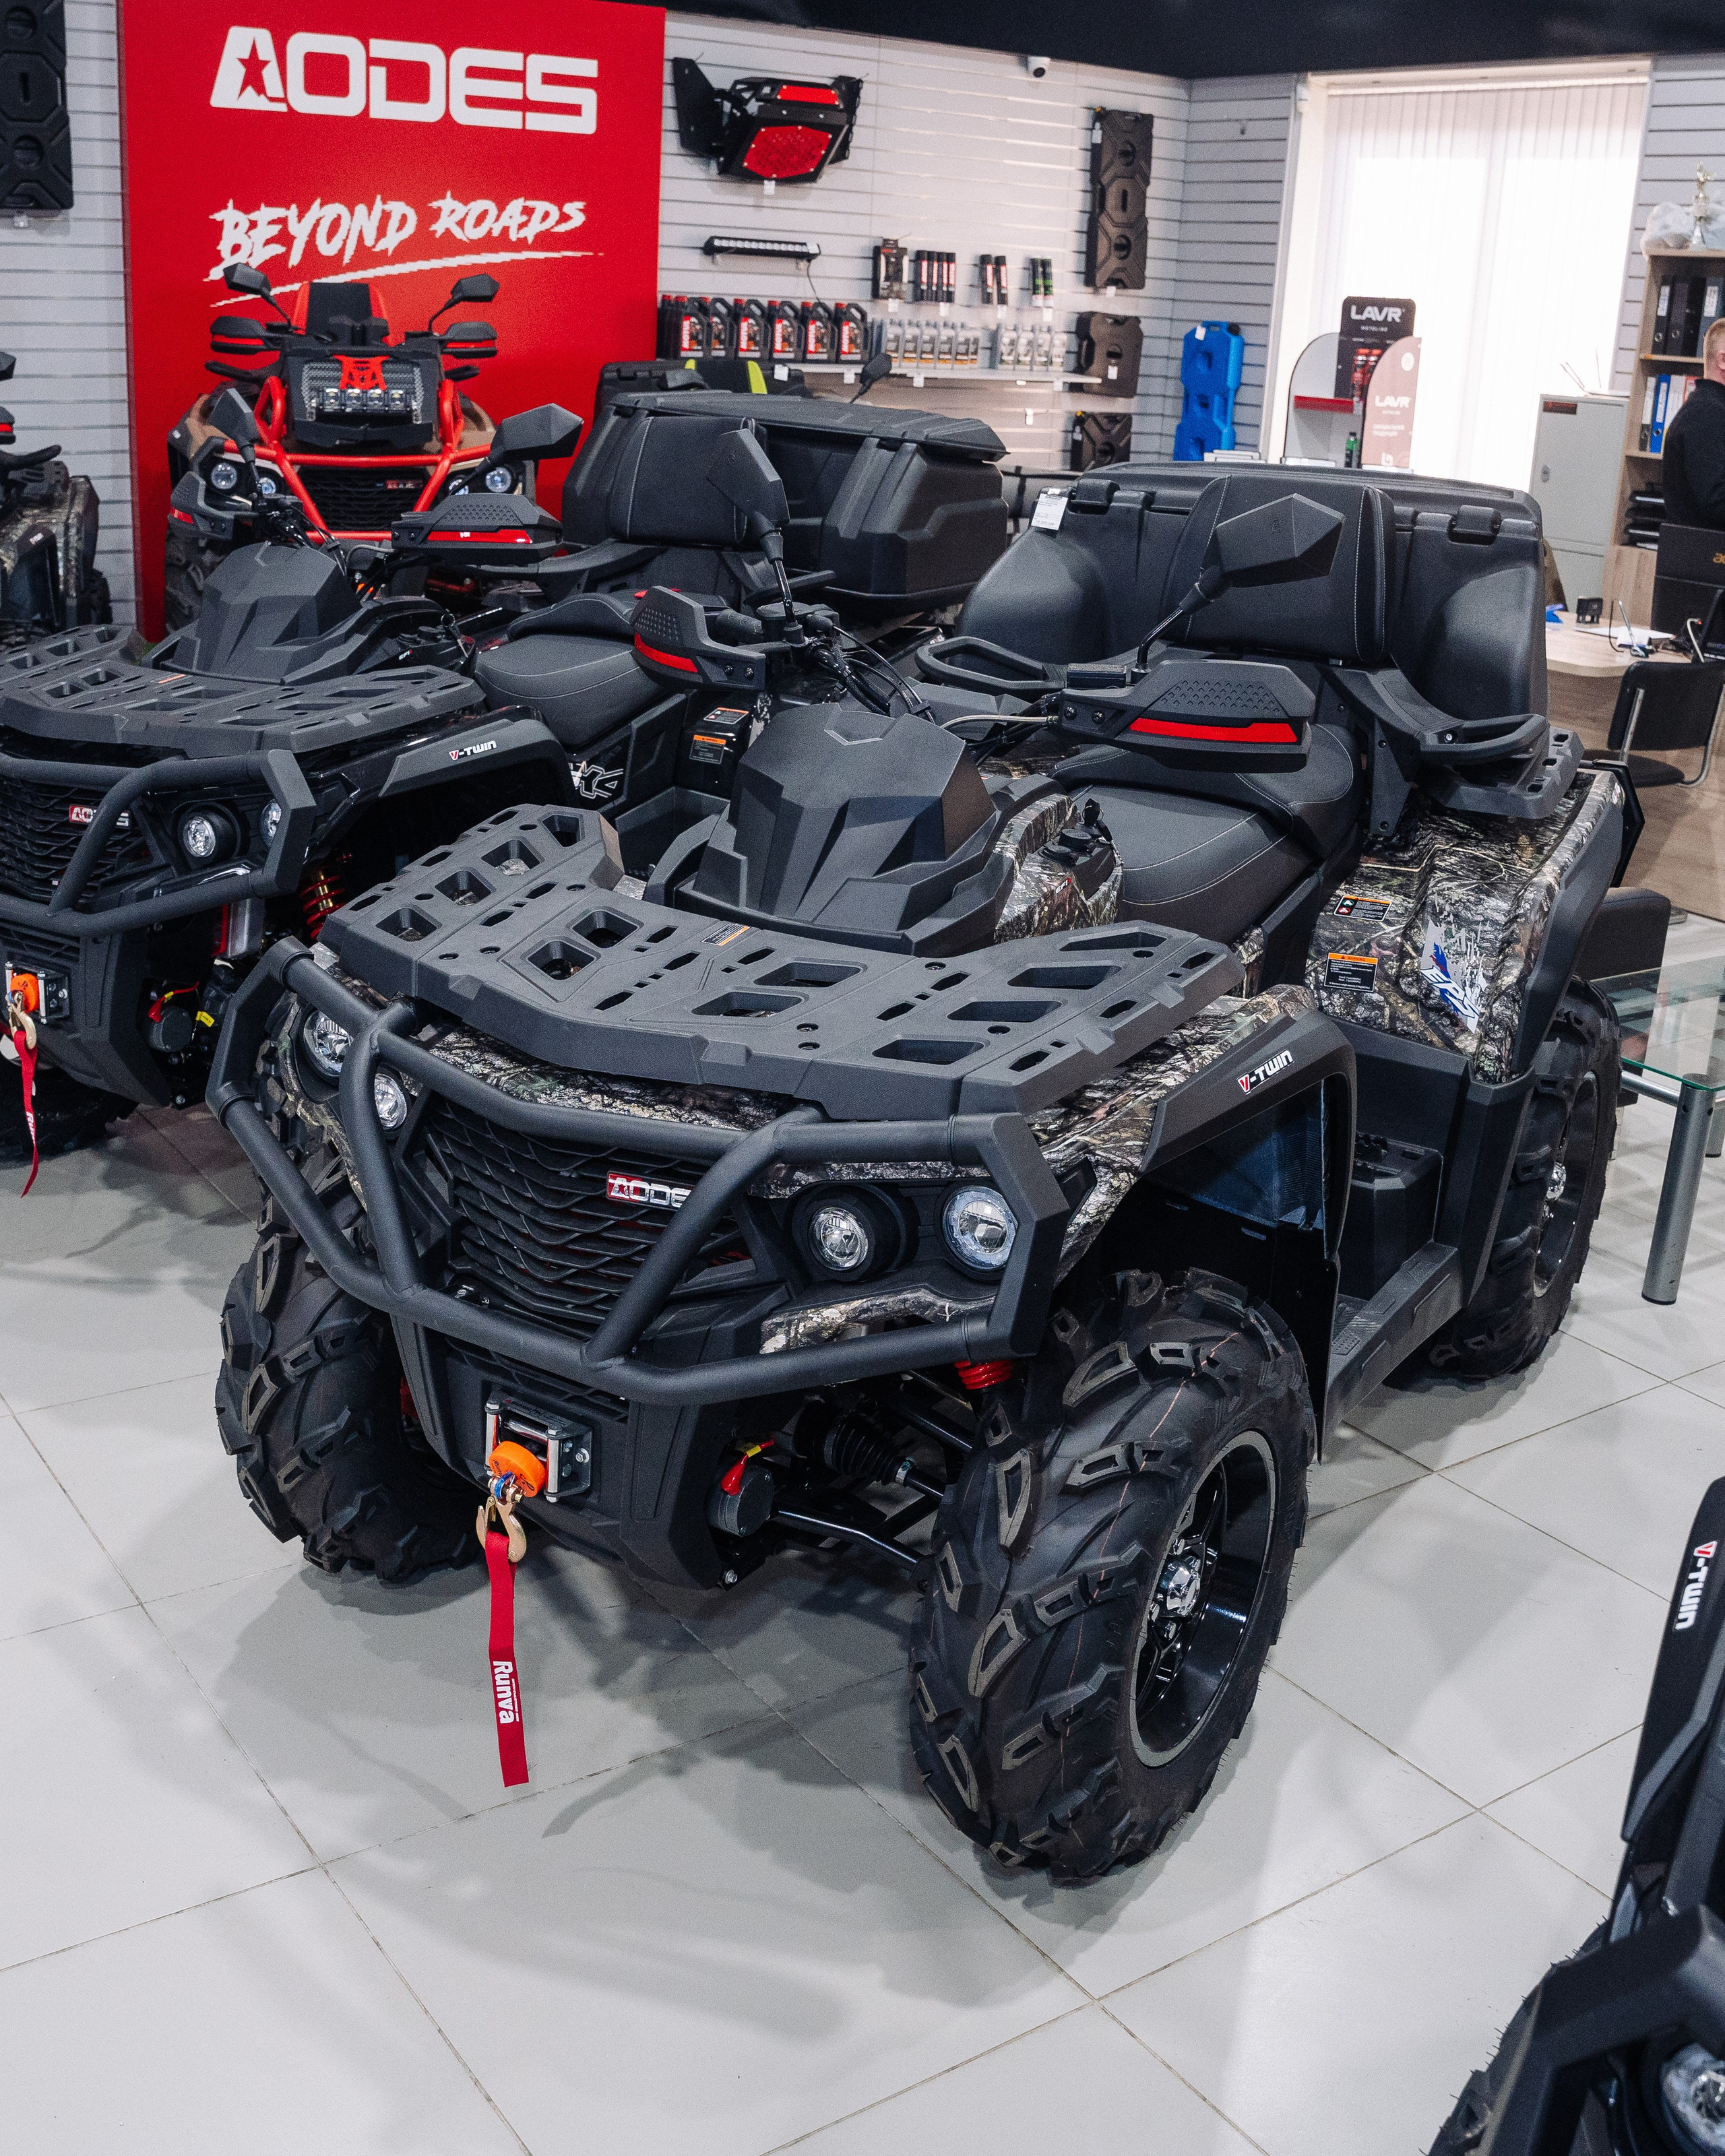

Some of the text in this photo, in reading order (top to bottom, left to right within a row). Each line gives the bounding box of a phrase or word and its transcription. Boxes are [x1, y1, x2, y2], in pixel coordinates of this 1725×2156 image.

[210, 26, 598, 135] AODES
[203, 191, 586, 282] BEYOND ROADS
[1350, 305, 1402, 323] LAVR
[1375, 395, 1410, 408] LAVR
[449, 740, 497, 761] V-TWIN
[1420, 965, 1480, 1018] EPS
[1237, 1050, 1294, 1093] V-TWIN
[608, 1177, 692, 1208] AODE
[1674, 1540, 1718, 1630] V-TWIN
[493, 1661, 515, 1724] Runva
